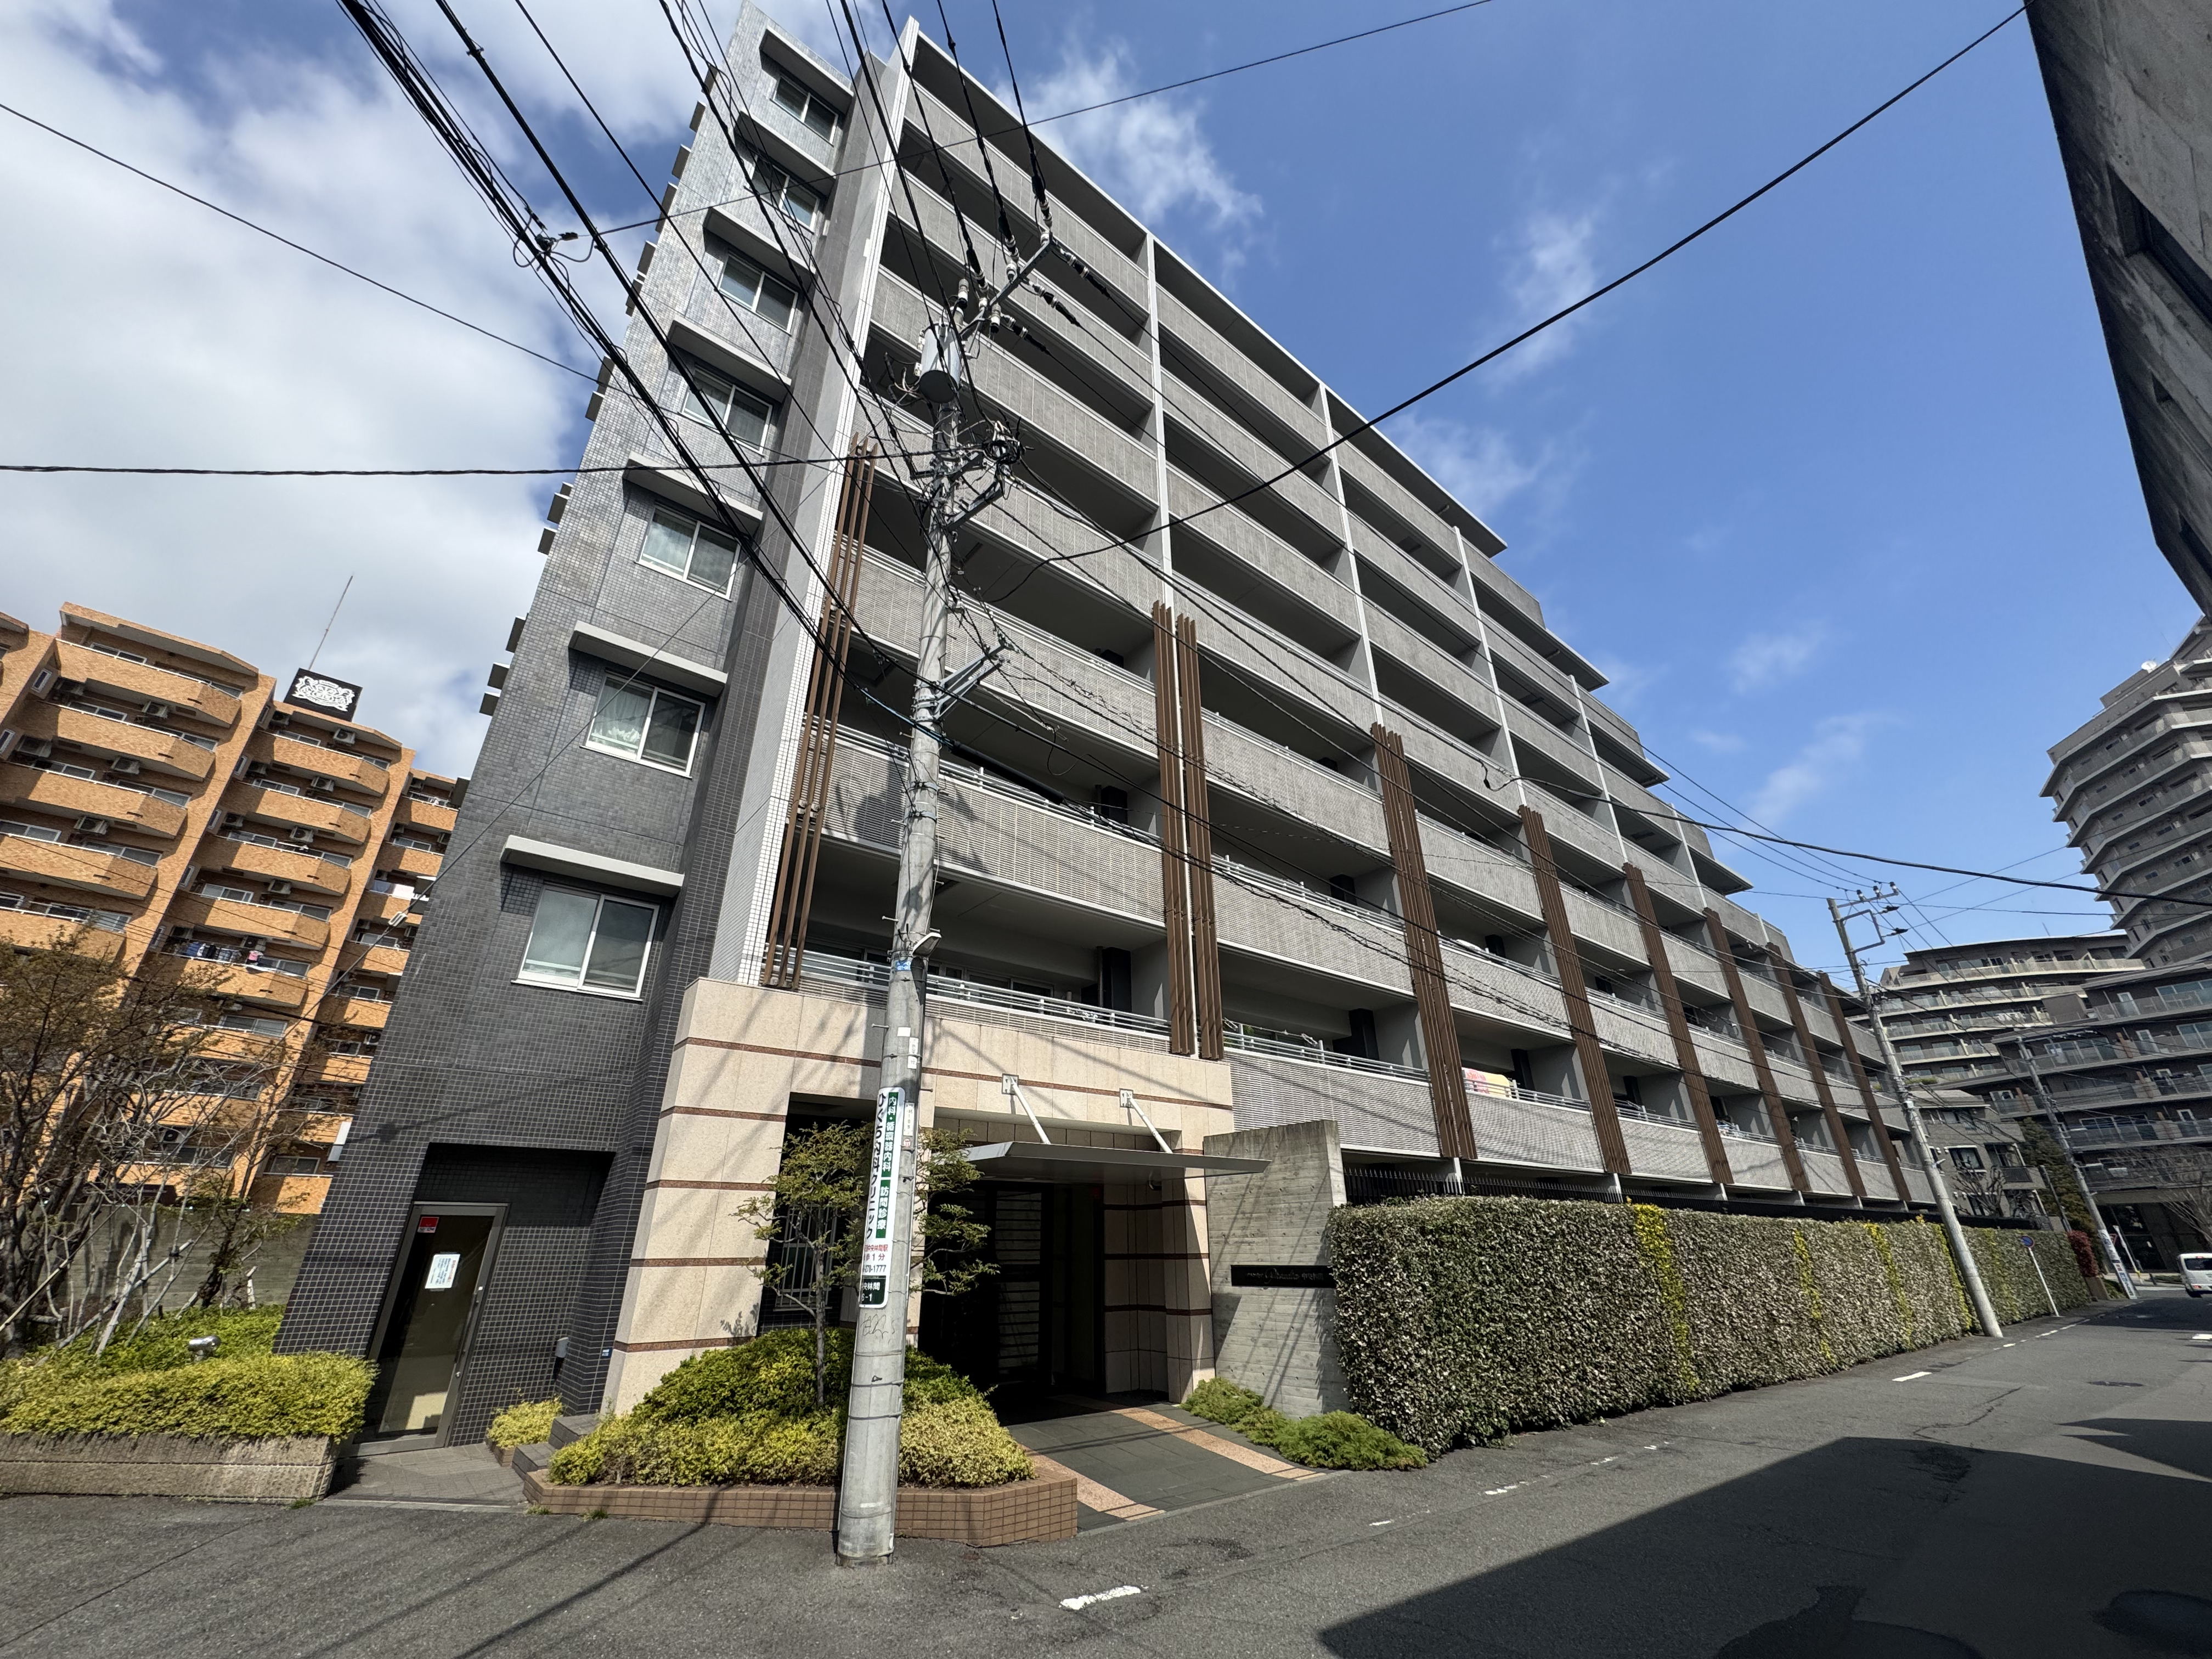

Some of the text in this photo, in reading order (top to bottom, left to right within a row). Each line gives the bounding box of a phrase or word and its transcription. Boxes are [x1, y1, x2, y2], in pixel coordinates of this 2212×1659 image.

[882, 1096, 897, 1172] 内科・循環器内科
[877, 1186, 889, 1230] 訪問診療
